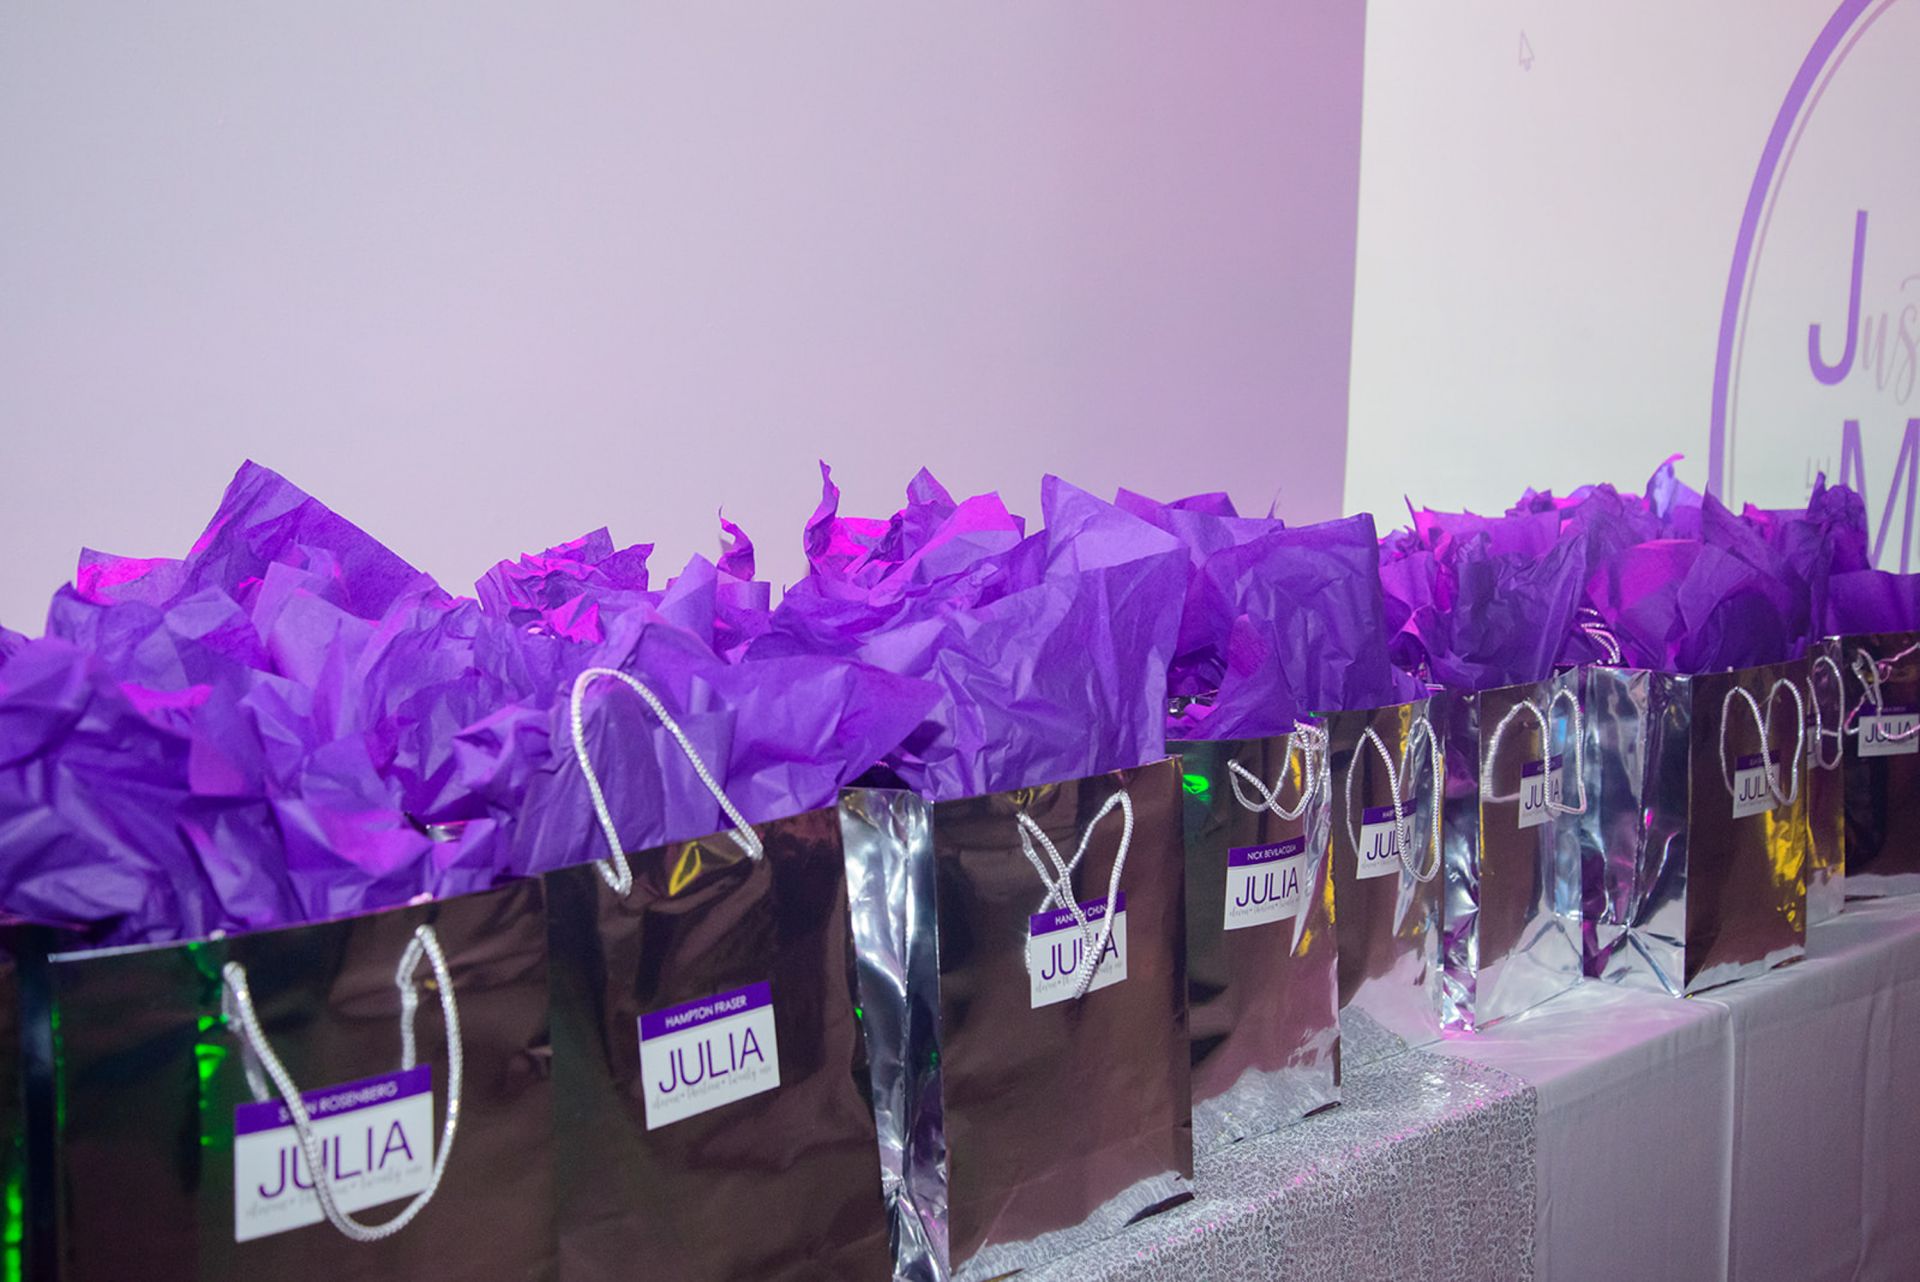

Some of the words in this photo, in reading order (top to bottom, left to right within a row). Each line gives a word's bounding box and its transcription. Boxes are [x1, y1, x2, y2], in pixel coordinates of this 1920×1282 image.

[1366, 825, 1412, 861] JULA
[1235, 867, 1299, 907] JULIA
[664, 1004, 714, 1029] HAMPTON
[714, 995, 749, 1014] FRASER
[658, 1026, 765, 1093] JULIA
[258, 1120, 414, 1199] JULIA
